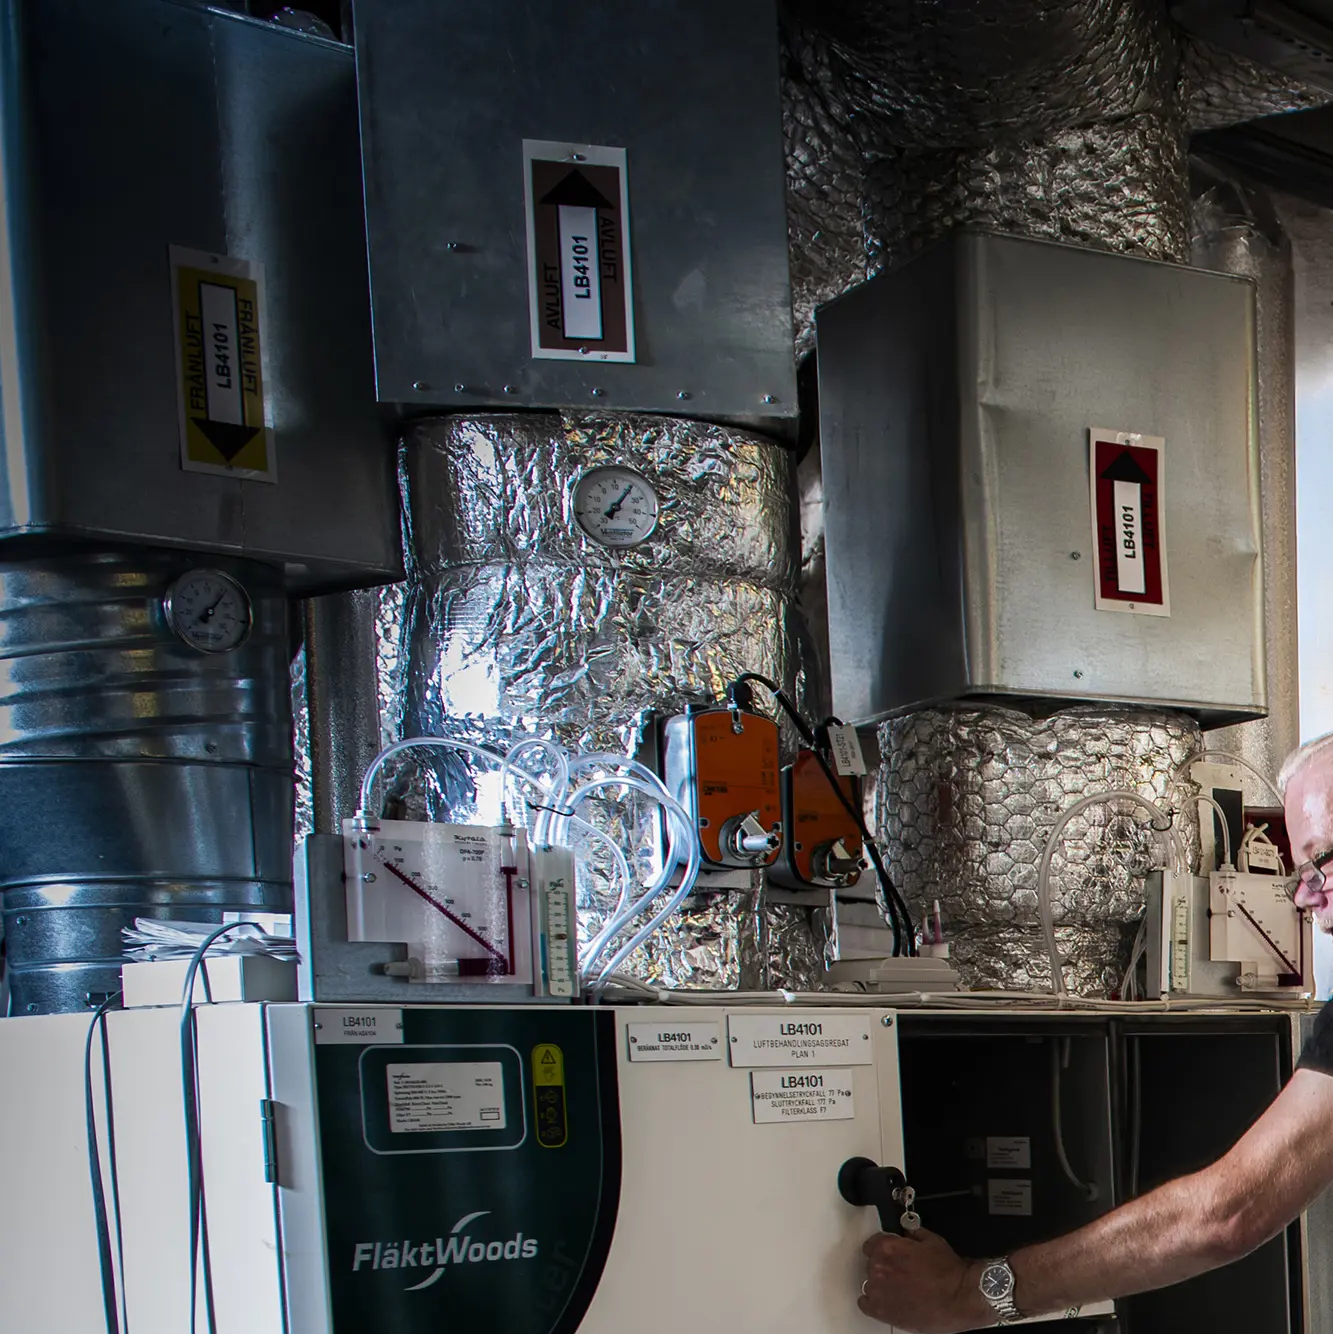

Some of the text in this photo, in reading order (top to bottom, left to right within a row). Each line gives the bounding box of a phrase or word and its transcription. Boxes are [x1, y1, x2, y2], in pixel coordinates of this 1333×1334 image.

[600, 216, 618, 282] AVLUFT
[572, 236, 591, 299] LB4101
[544, 262, 561, 330] AVLUFT
[213, 323, 232, 389] LB4101
[1122, 505, 1136, 559] LB4101
[343, 1016, 377, 1027] LB4101
[780, 1023, 823, 1036] LB4101
[658, 1032, 692, 1043] LB4101
[753, 1038, 850, 1049] LUFTBEHANDLINGSAGGREGAT
[791, 1050, 816, 1059] PLAN 1
[781, 1075, 824, 1089] LB4101
[760, 1089, 826, 1100] BEGYNNELSETRYCKFALL
[837, 1089, 845, 1097] Pa
[771, 1099, 815, 1108] SLUTTRYCKFALL
[828, 1098, 837, 1106] Pa
[781, 1107, 818, 1116] FILTERKLASS
